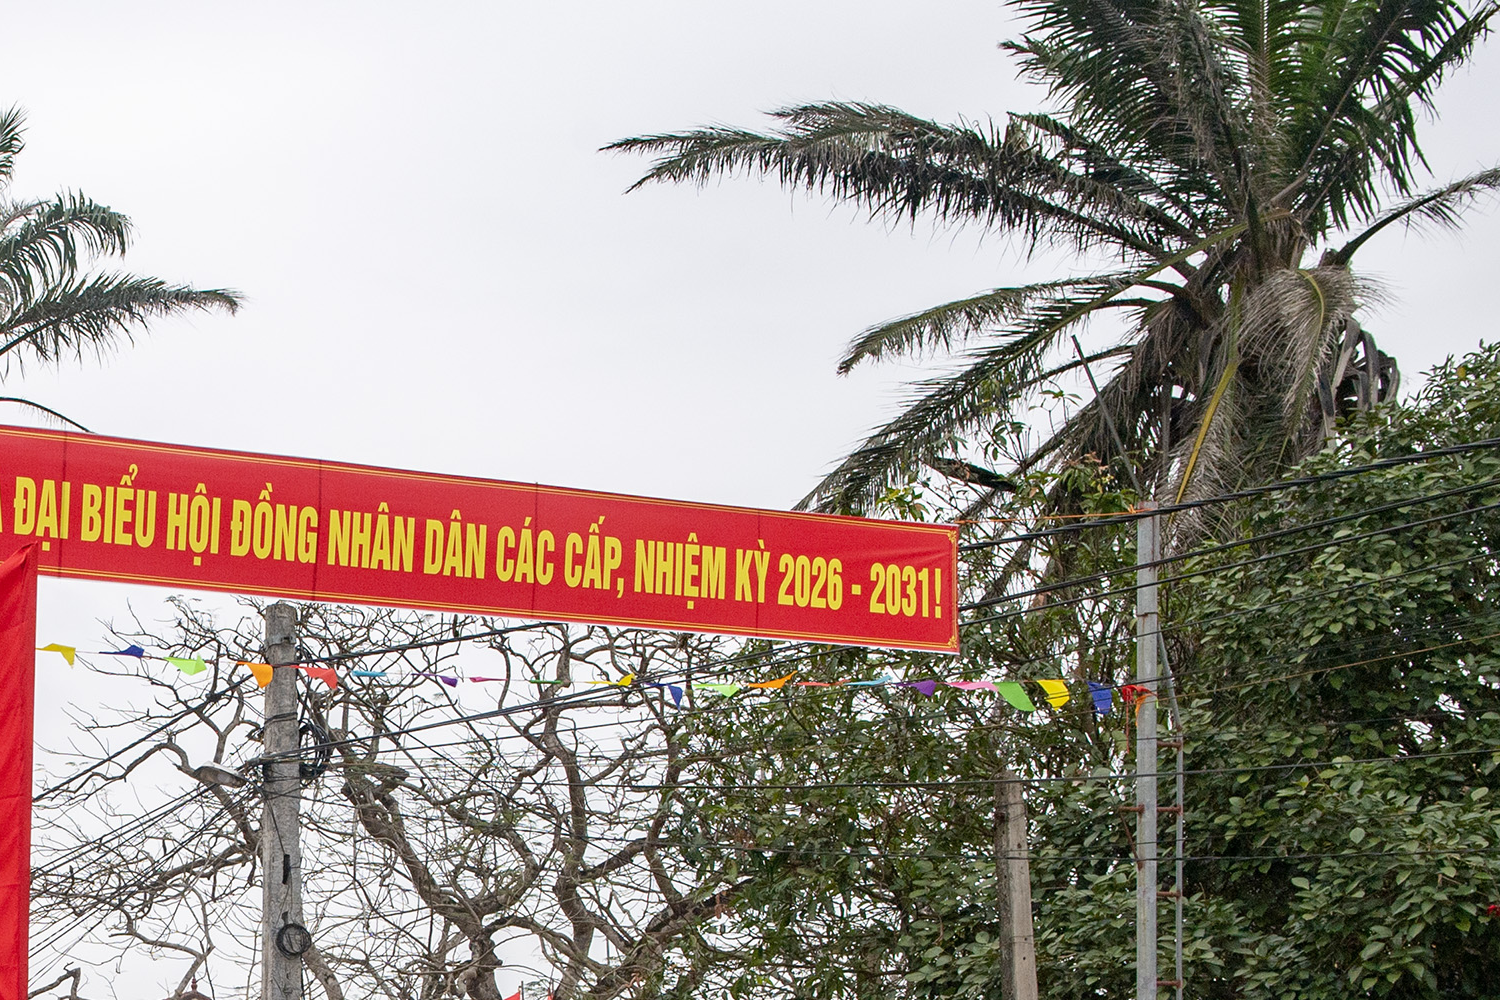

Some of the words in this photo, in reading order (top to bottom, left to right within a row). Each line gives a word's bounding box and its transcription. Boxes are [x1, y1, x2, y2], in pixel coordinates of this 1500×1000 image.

[13, 476, 71, 552] ĐẠI
[80, 463, 157, 548] BIỂU
[166, 482, 221, 566] HỘI
[230, 482, 319, 564] ĐỒNG
[327, 501, 416, 573] NHÂN
[423, 509, 487, 579] DÂN
[495, 516, 555, 586] CÁC
[564, 515, 625, 599] CẤP,
[634, 532, 727, 610] NHIỆM
[734, 539, 771, 604] KỲ
[777, 553, 843, 611] 2026
[851, 584, 862, 596] -
[869, 562, 942, 619] 2031!
